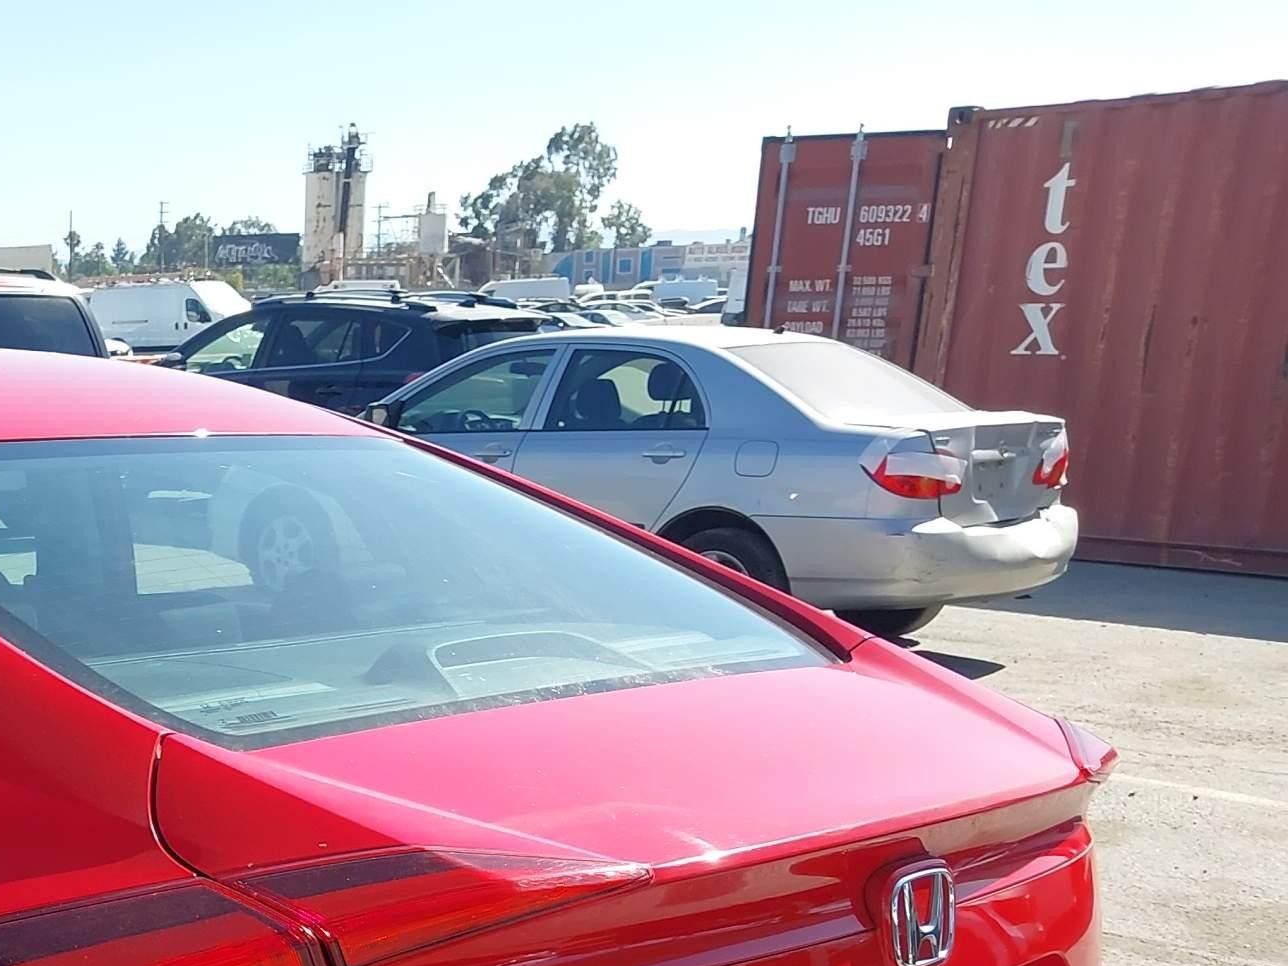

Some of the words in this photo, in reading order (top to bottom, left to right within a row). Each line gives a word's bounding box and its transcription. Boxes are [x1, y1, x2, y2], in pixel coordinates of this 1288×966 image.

[806, 207, 841, 225] TGHU
[859, 205, 912, 223] 609322
[917, 203, 929, 223] 4
[856, 228, 890, 246] 45G1
[789, 280, 812, 292] MAX.
[815, 279, 832, 292] WT.
